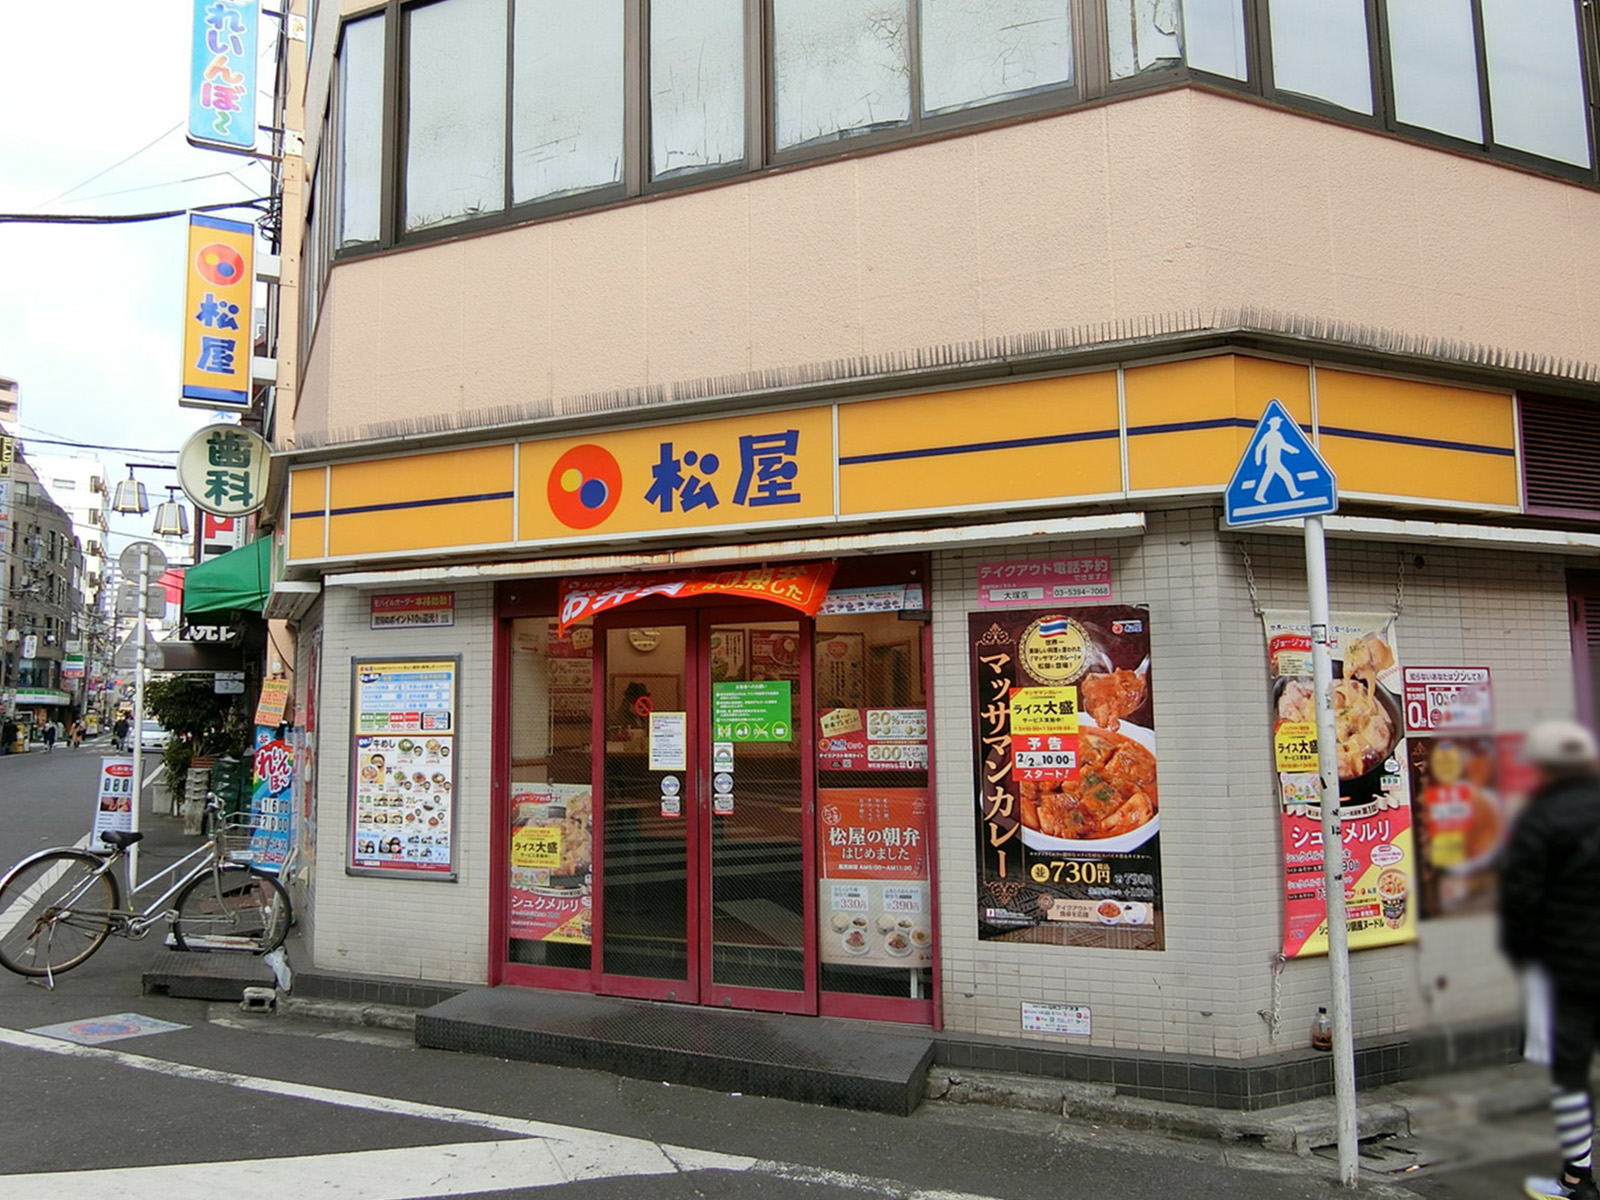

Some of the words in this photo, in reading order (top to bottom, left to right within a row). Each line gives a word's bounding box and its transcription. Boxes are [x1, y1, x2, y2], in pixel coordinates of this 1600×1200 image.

[195, 293, 240, 375] 松屋
[204, 430, 254, 507] 歯科
[643, 428, 801, 513] 松屋
[981, 559, 1108, 579] テイクアウト電話予約
[1004, 591, 1029, 600] 大塚店
[1054, 587, 1109, 597] 03-5394-7068
[1013, 700, 1075, 715] ライス大盛
[1027, 736, 1063, 751] 予告
[980, 652, 1019, 878] マッサマンカレー
[1023, 769, 1070, 779] スタート!
[829, 827, 920, 847] 松屋の朝弁
[1291, 819, 1391, 849] シュメルリ
[514, 841, 558, 854] ライス大盛
[841, 847, 910, 861] はじめました
[511, 895, 579, 912] シュクメルリ
